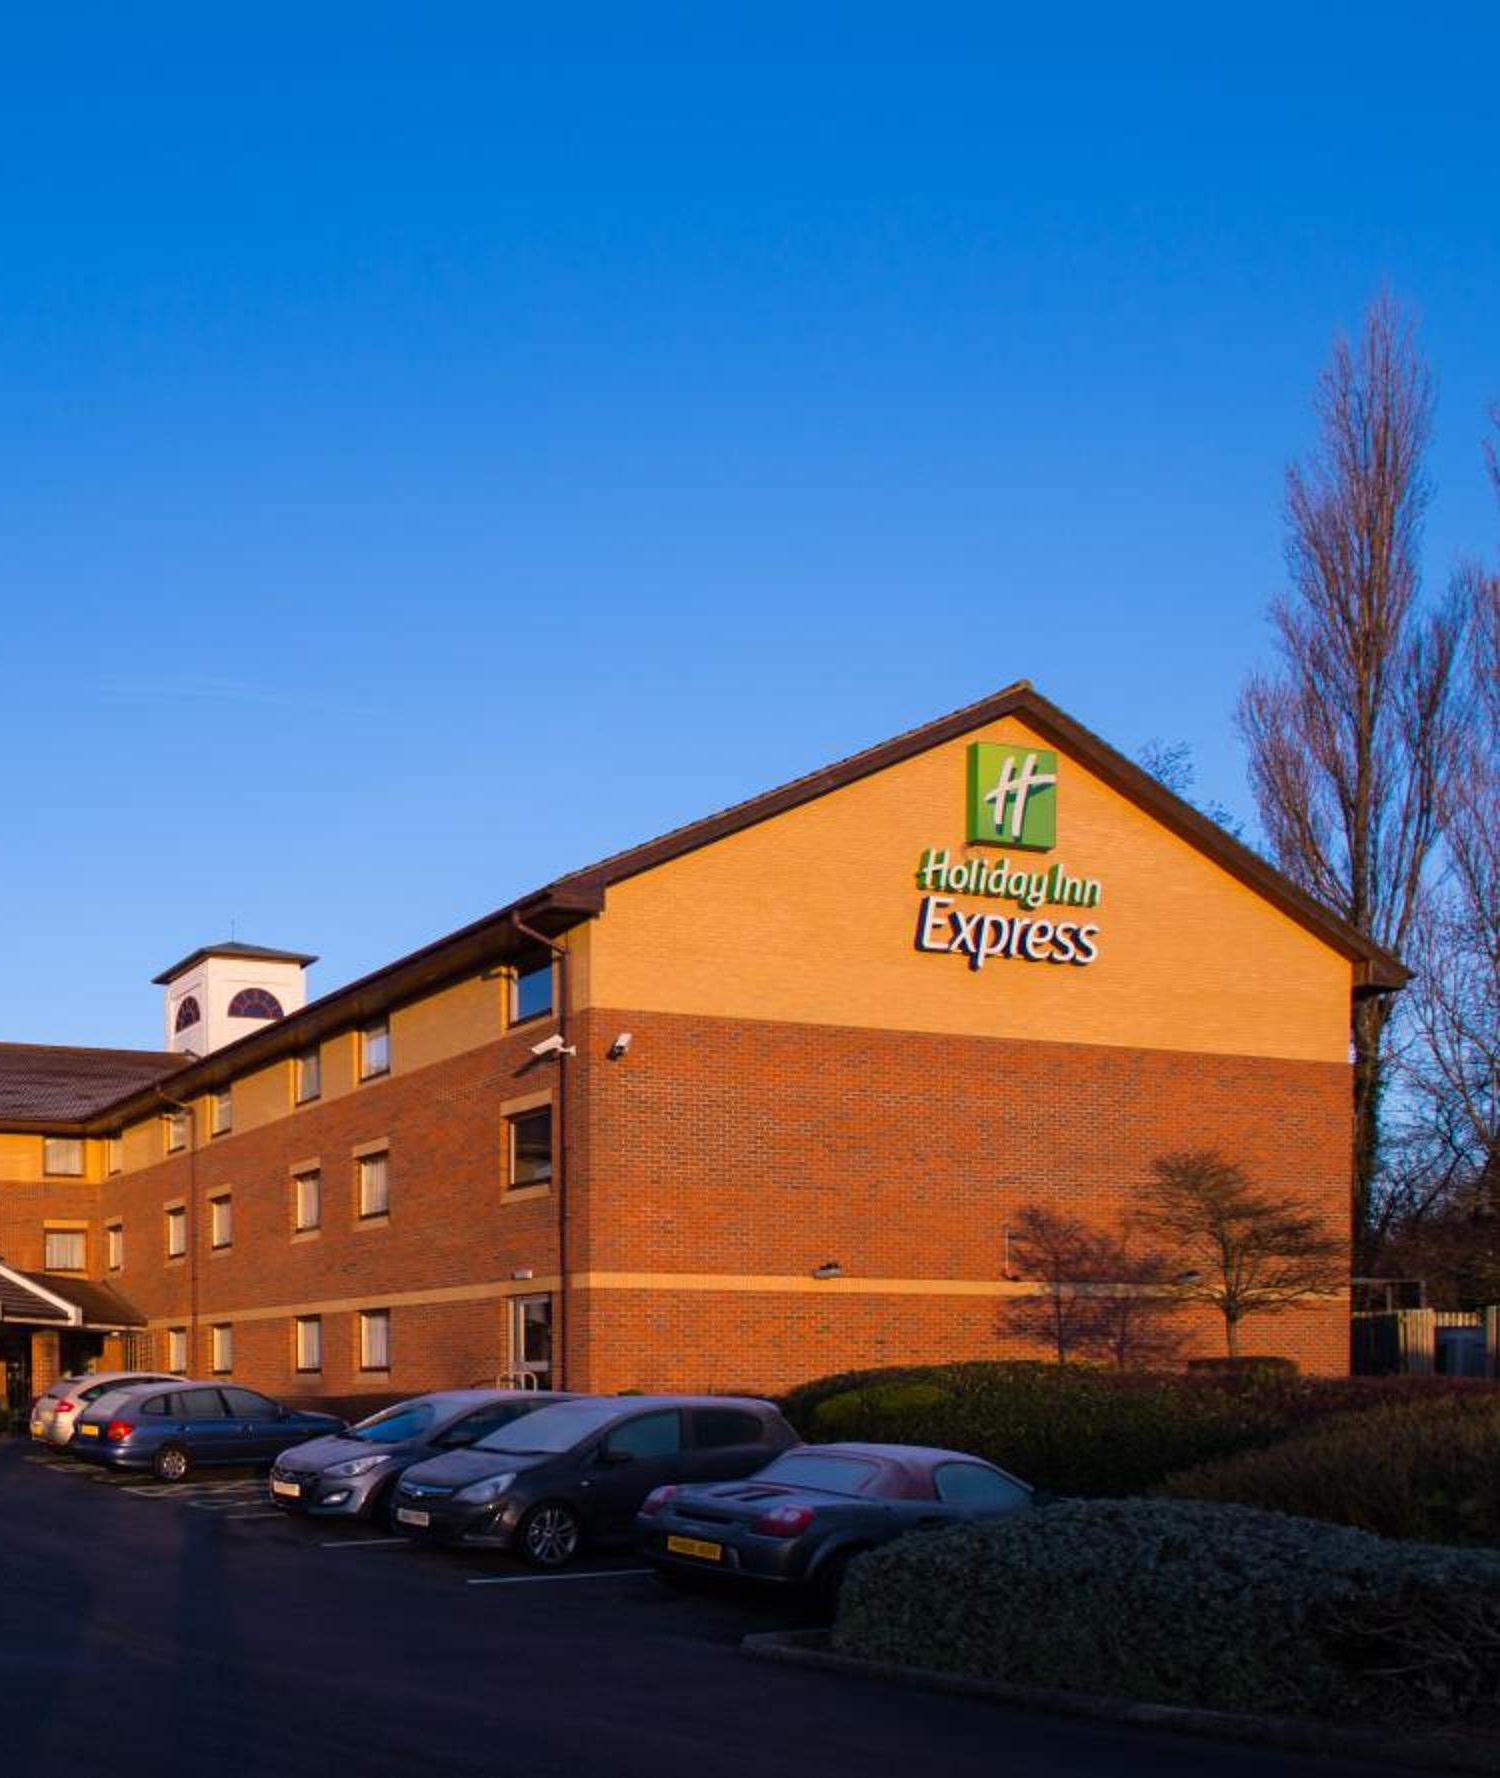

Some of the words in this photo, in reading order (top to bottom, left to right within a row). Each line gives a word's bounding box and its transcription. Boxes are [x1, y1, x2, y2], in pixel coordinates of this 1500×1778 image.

[984, 753, 1056, 839] H
[916, 847, 1049, 909] Holiday
[1050, 863, 1102, 907] Inn
[915, 895, 1101, 971] Express
